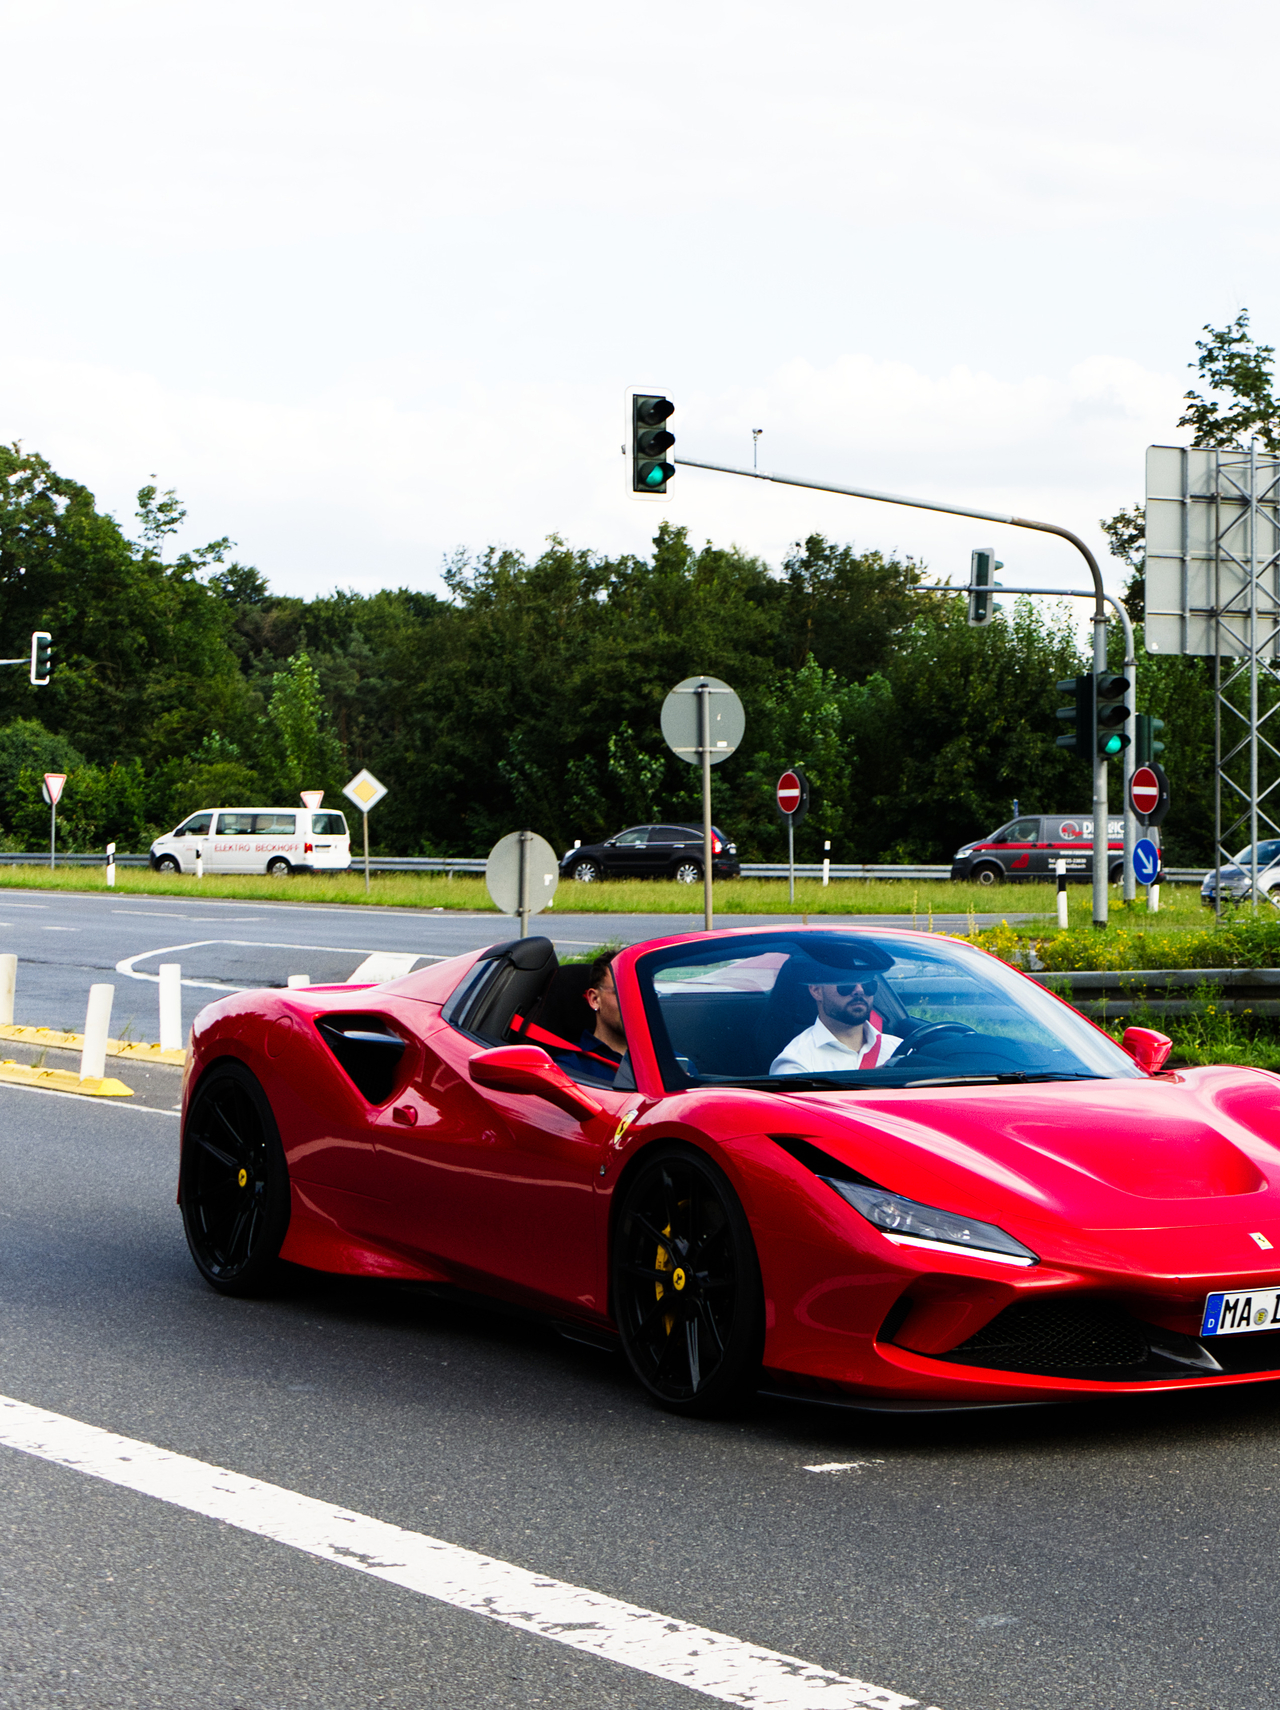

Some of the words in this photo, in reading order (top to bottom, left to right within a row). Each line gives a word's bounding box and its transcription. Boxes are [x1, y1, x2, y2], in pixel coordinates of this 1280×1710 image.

[214, 843, 251, 852] ELEKTRO
[255, 843, 300, 852] BECKHOFF
[1219, 1297, 1253, 1330] MA
[1207, 1318, 1215, 1328] D
